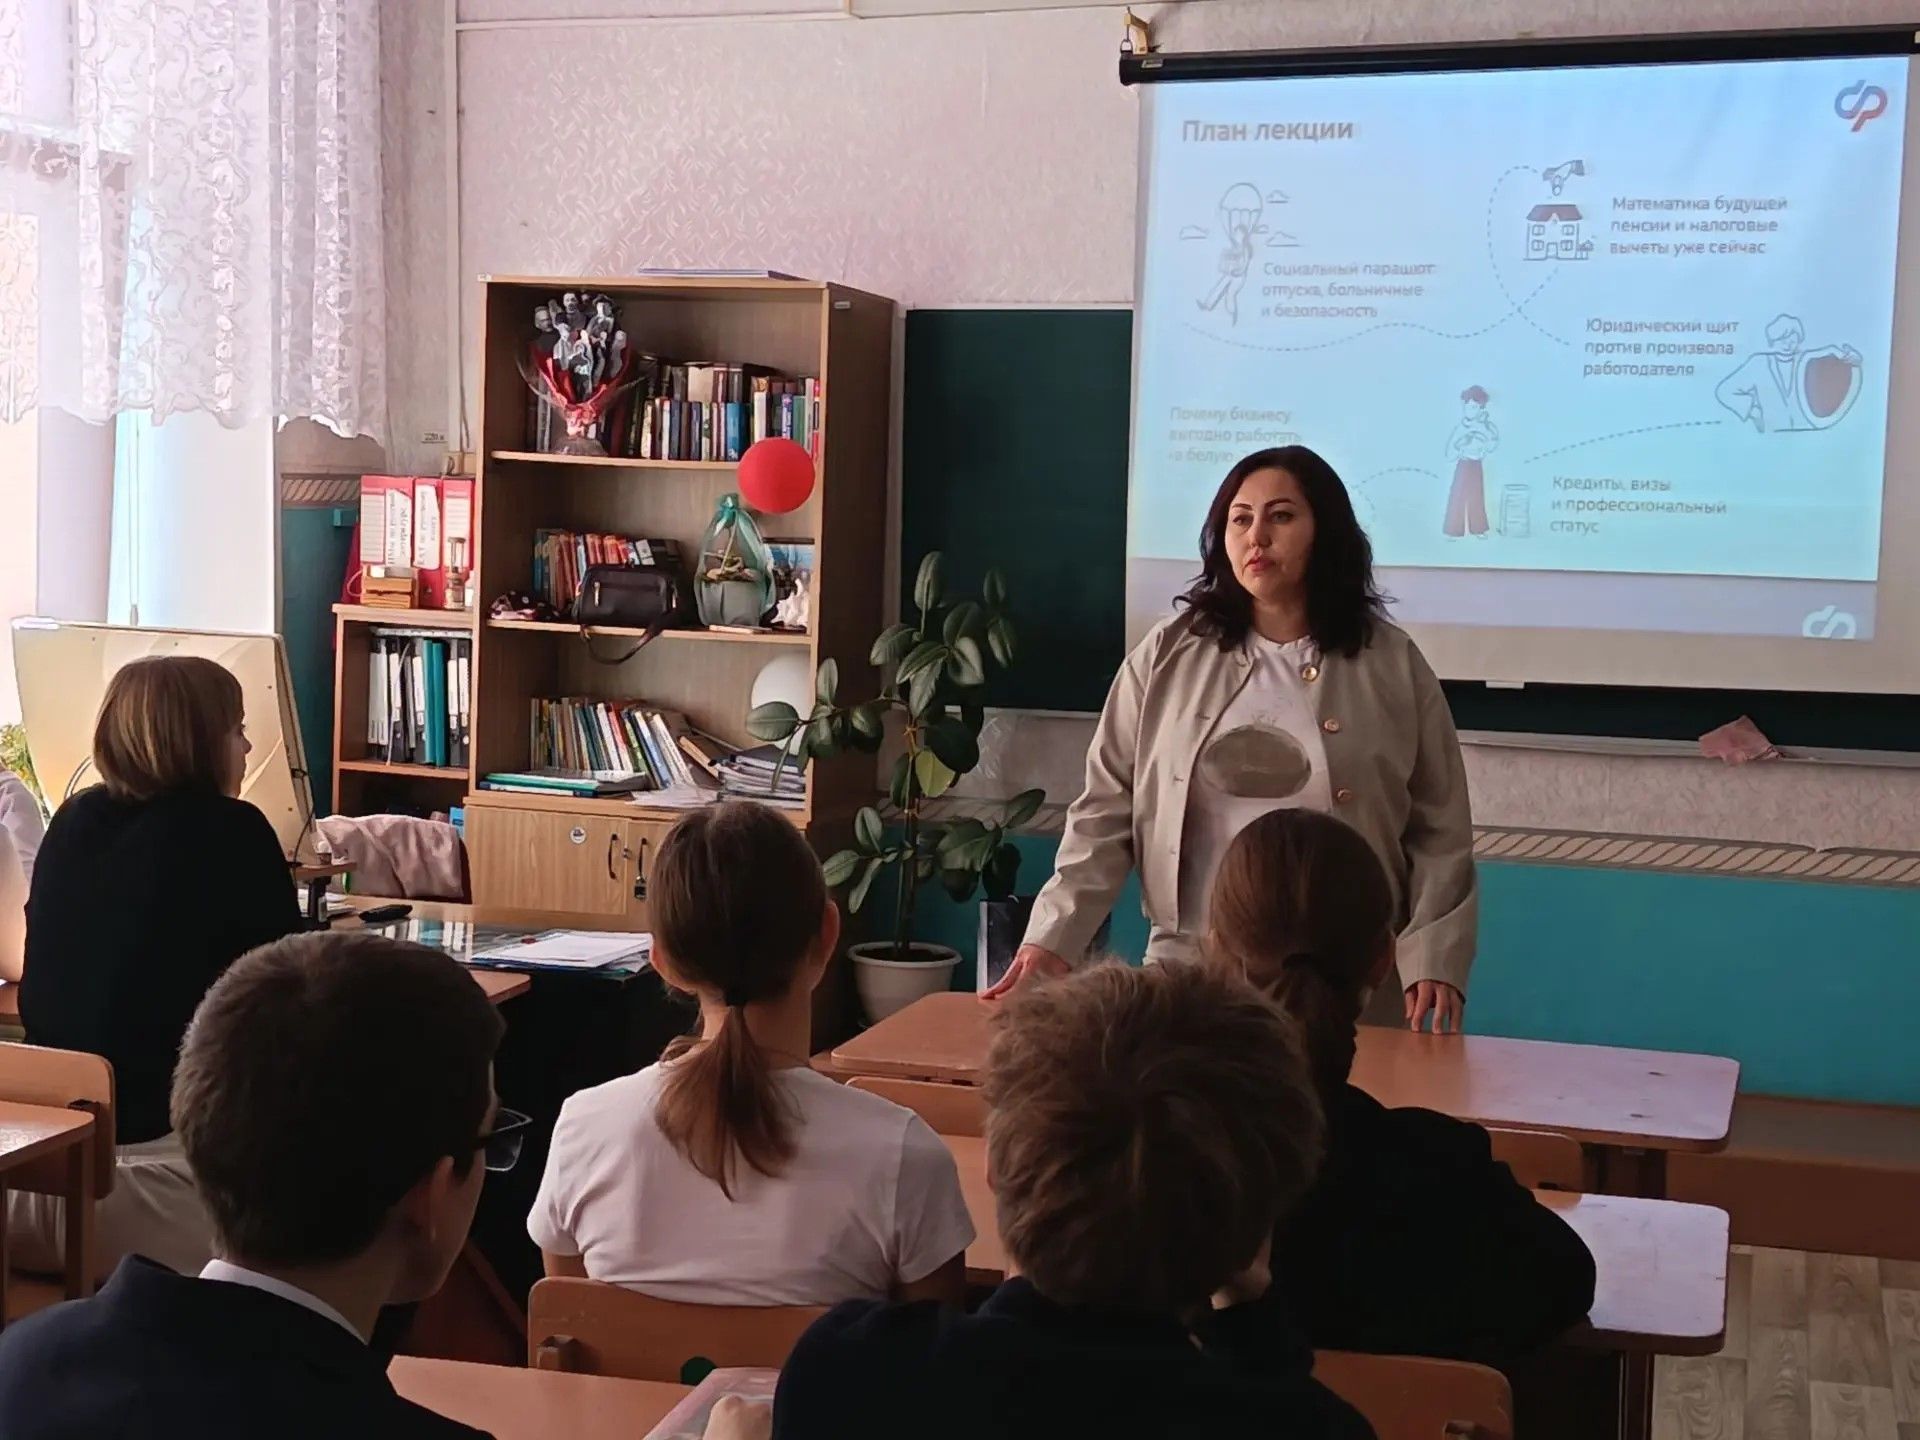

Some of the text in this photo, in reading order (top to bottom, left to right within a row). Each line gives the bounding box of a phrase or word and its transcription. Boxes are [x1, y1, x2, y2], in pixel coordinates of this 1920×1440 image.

[1182, 120, 1354, 143] План лекции
[1612, 195, 1788, 214] Математика будущей
[1610, 218, 1779, 232] пенсии и налоговые
[1609, 239, 1766, 258] вычеты уже сейчас
[1263, 261, 1436, 278] Социальный парашют
[1262, 282, 1425, 300] отпуска, больничные
[1261, 303, 1379, 318] и безопасность
[1585, 317, 1739, 334] Юридический щит
[1584, 341, 1735, 357] против произвола
[1583, 361, 1695, 379] работодателя
[1170, 406, 1227, 424] Почему
[1630, 478, 1672, 492] визы
[1551, 497, 1727, 515] и профессиональный
[1550, 519, 1600, 535] статус
